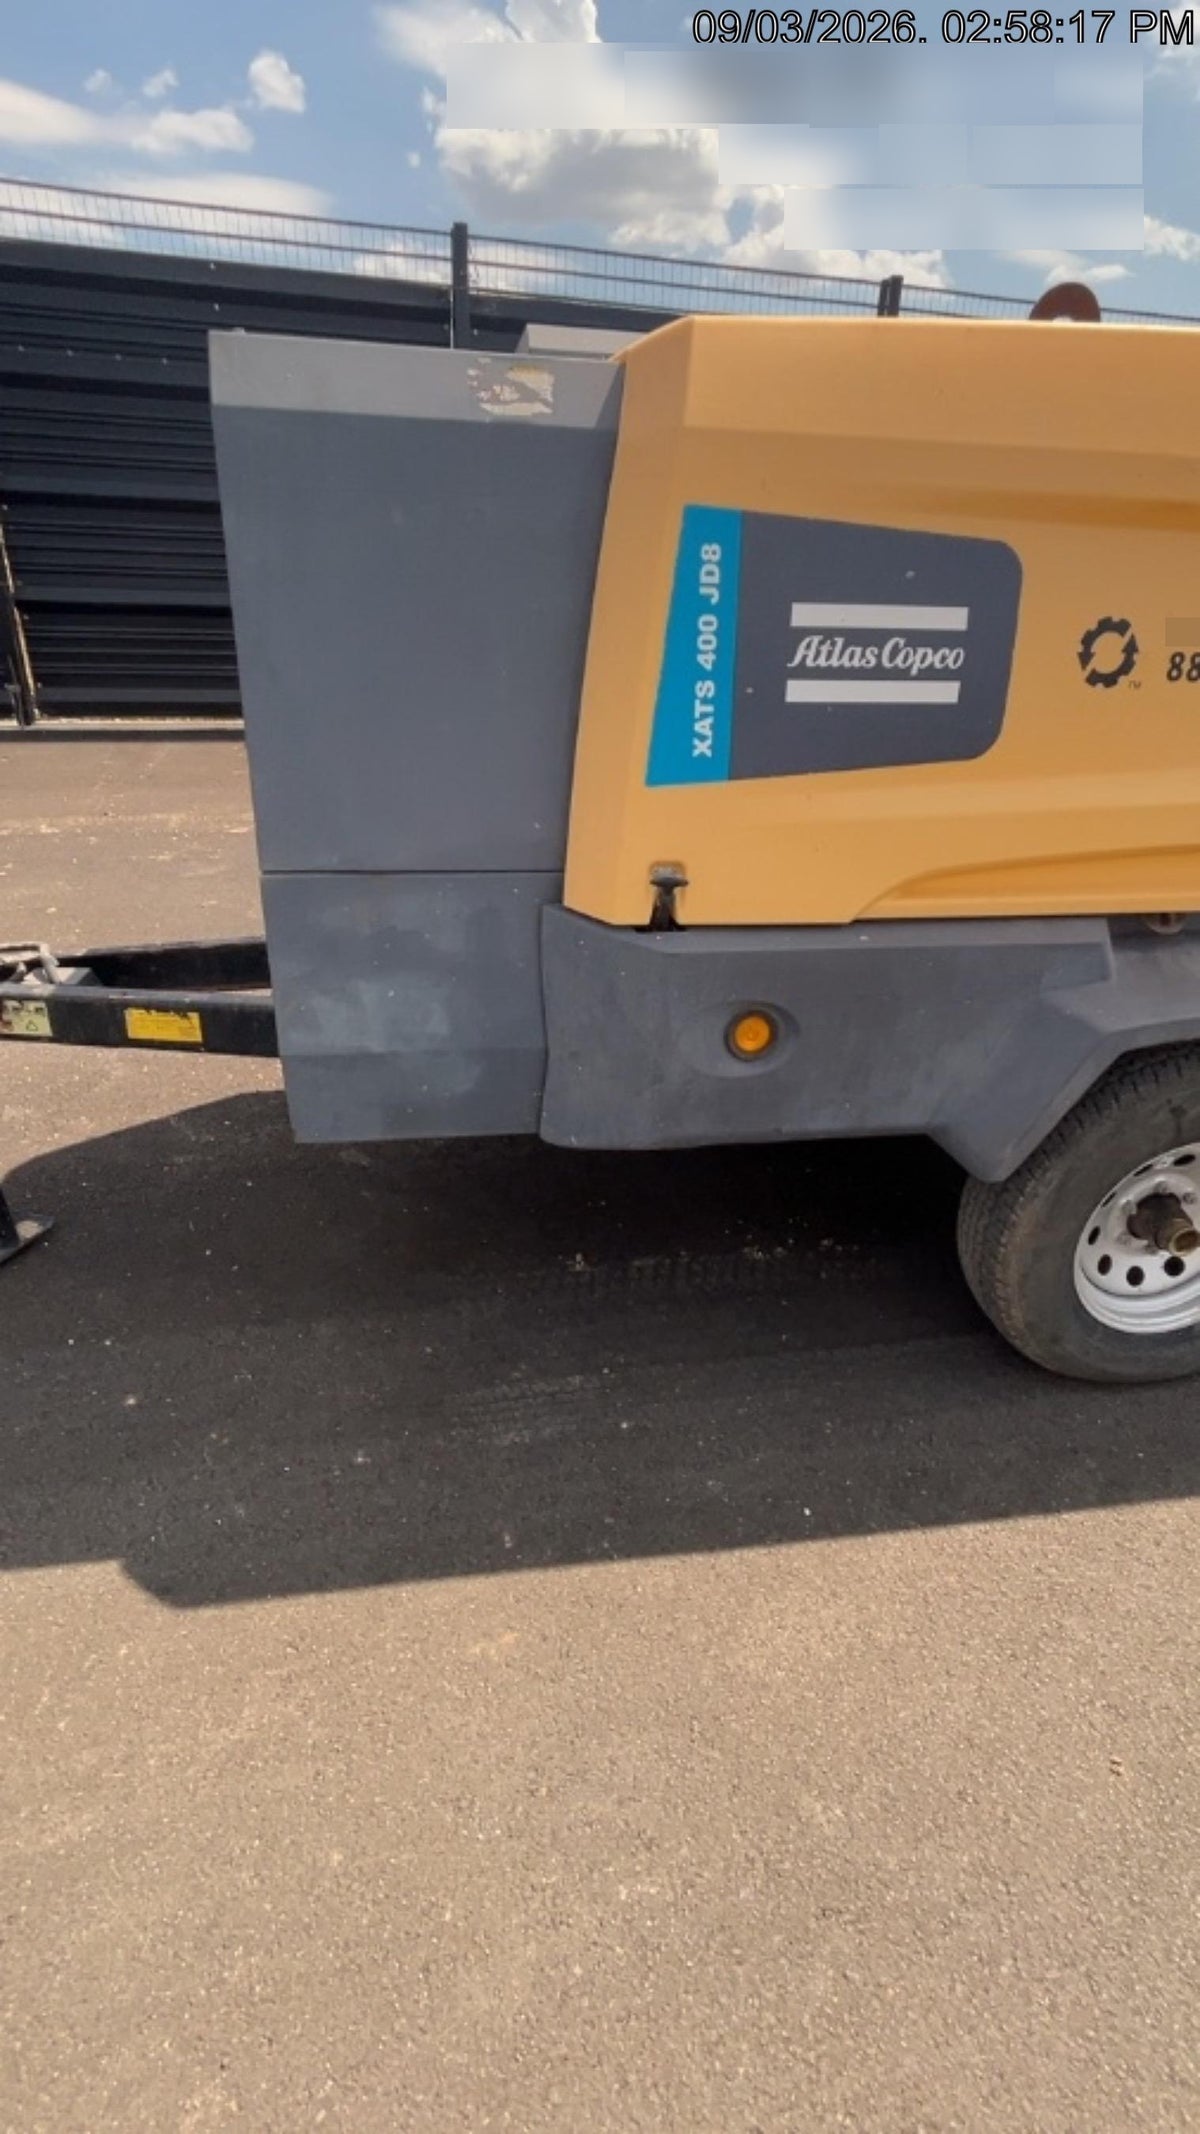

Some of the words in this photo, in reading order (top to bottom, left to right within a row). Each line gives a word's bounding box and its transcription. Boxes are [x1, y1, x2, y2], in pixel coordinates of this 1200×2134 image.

[699, 542, 721, 605] JD8
[697, 614, 718, 671] 400
[787, 635, 878, 668] Atlas
[881, 637, 965, 676] Copco
[692, 680, 715, 758] XATS
